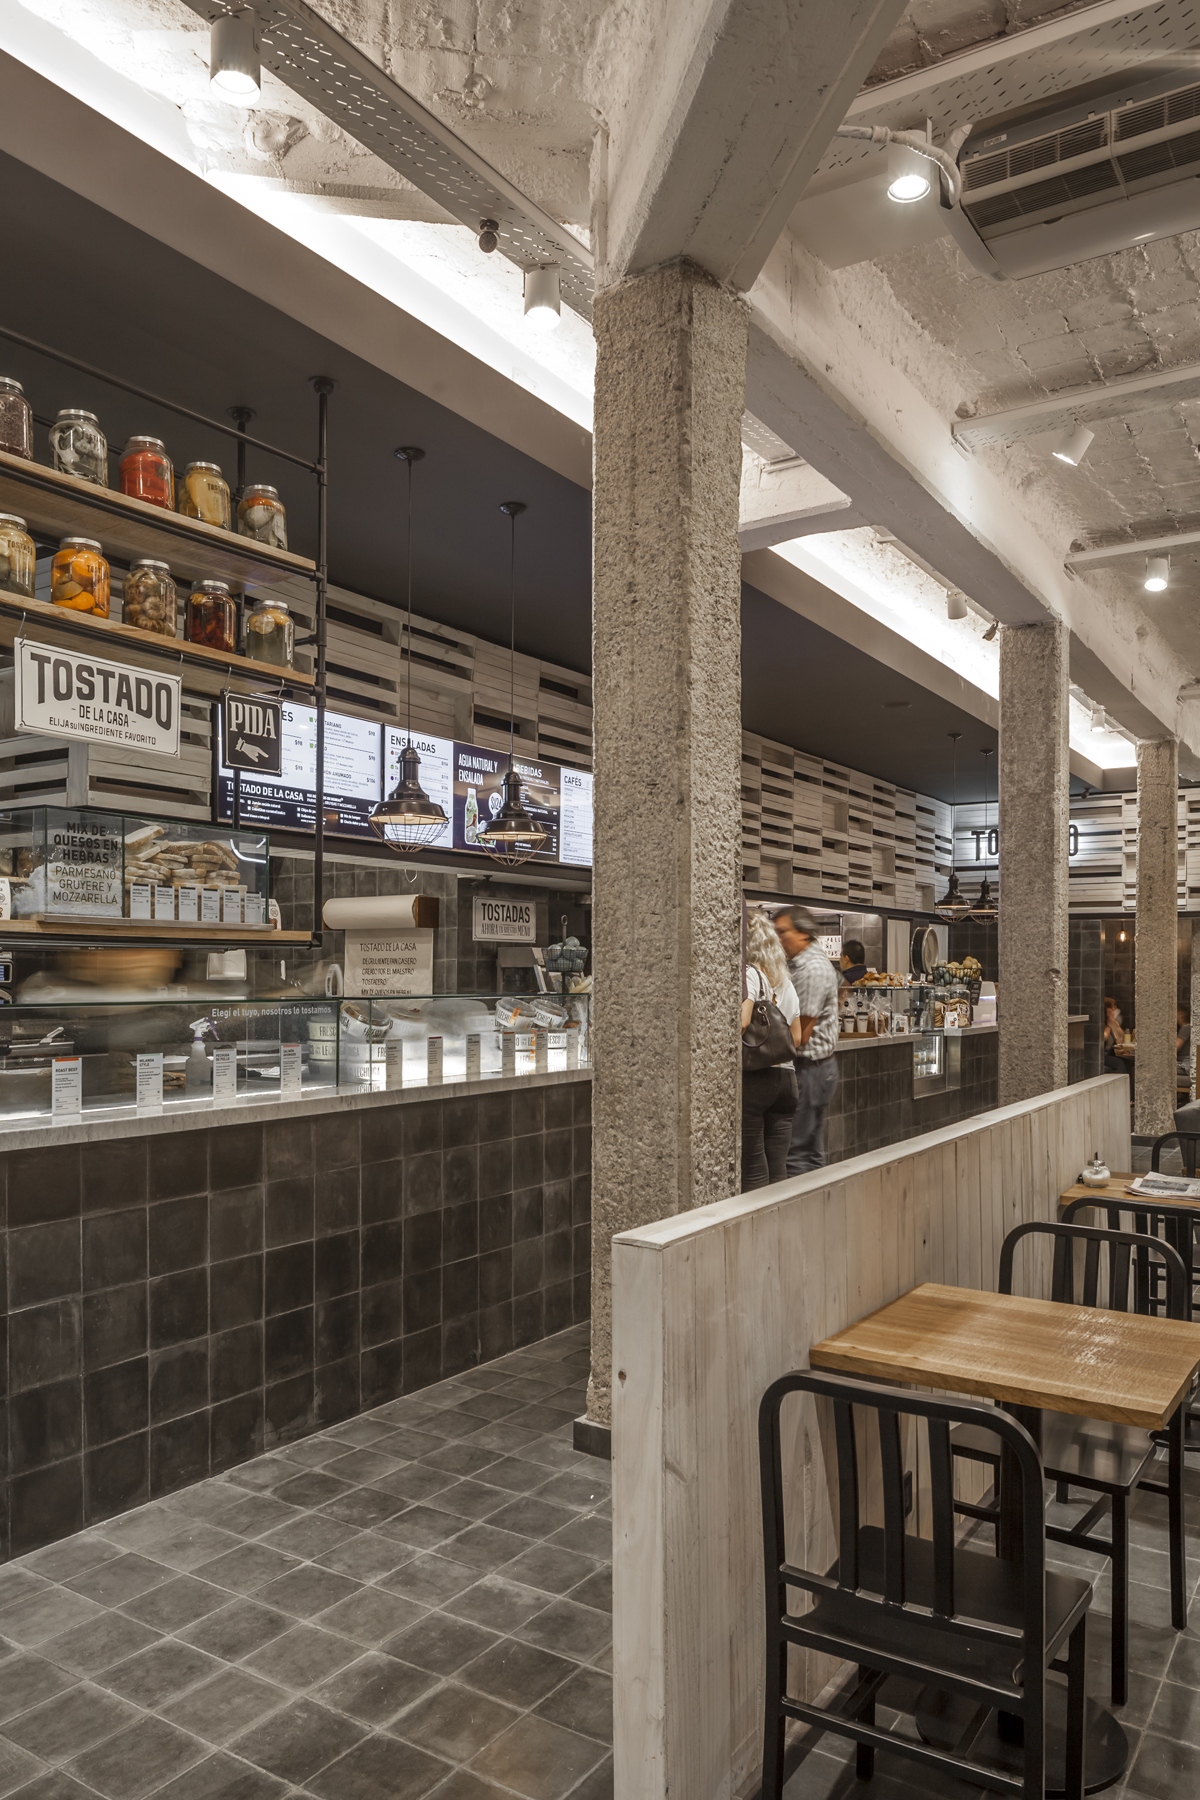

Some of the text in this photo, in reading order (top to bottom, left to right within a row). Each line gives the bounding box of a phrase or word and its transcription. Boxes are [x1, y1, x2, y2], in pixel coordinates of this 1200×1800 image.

[30, 652, 172, 731] TOSTADO
[79, 704, 129, 727] DE LA CASA
[229, 701, 276, 739] PIDA
[124, 732, 156, 745] FAVORITO
[390, 735, 436, 753] ENSLADAS
[458, 753, 472, 768] AGUA
[472, 757, 494, 773] NATURAL
[493, 761, 498, 773] Y
[515, 763, 542, 777] BEBIDAS
[458, 769, 483, 786] ENSALADA
[564, 774, 582, 786] CAFÉS
[226, 781, 261, 795] TTADO
[262, 787, 273, 796] DE
[274, 788, 284, 798] LA
[285, 790, 304, 801] CASA
[66, 822, 106, 836] MIX DE
[54, 834, 118, 850] QUESOS EN
[56, 866, 116, 880] PARMESANO
[59, 879, 112, 892] GRUYERE Y
[53, 891, 118, 904] MOZZARELLA
[481, 903, 530, 923] TOSTADAS
[481, 923, 498, 935] AHORA
[360, 943, 416, 952] TOSTADO DE LA CASA
[212, 1008, 231, 1018] Elegí
[233, 1008, 240, 1017] el
[261, 1007, 292, 1015] nosotros
[293, 1006, 300, 1015] lo
[301, 1006, 331, 1014] tostamos
[320, 1024, 336, 1036] FRESC
